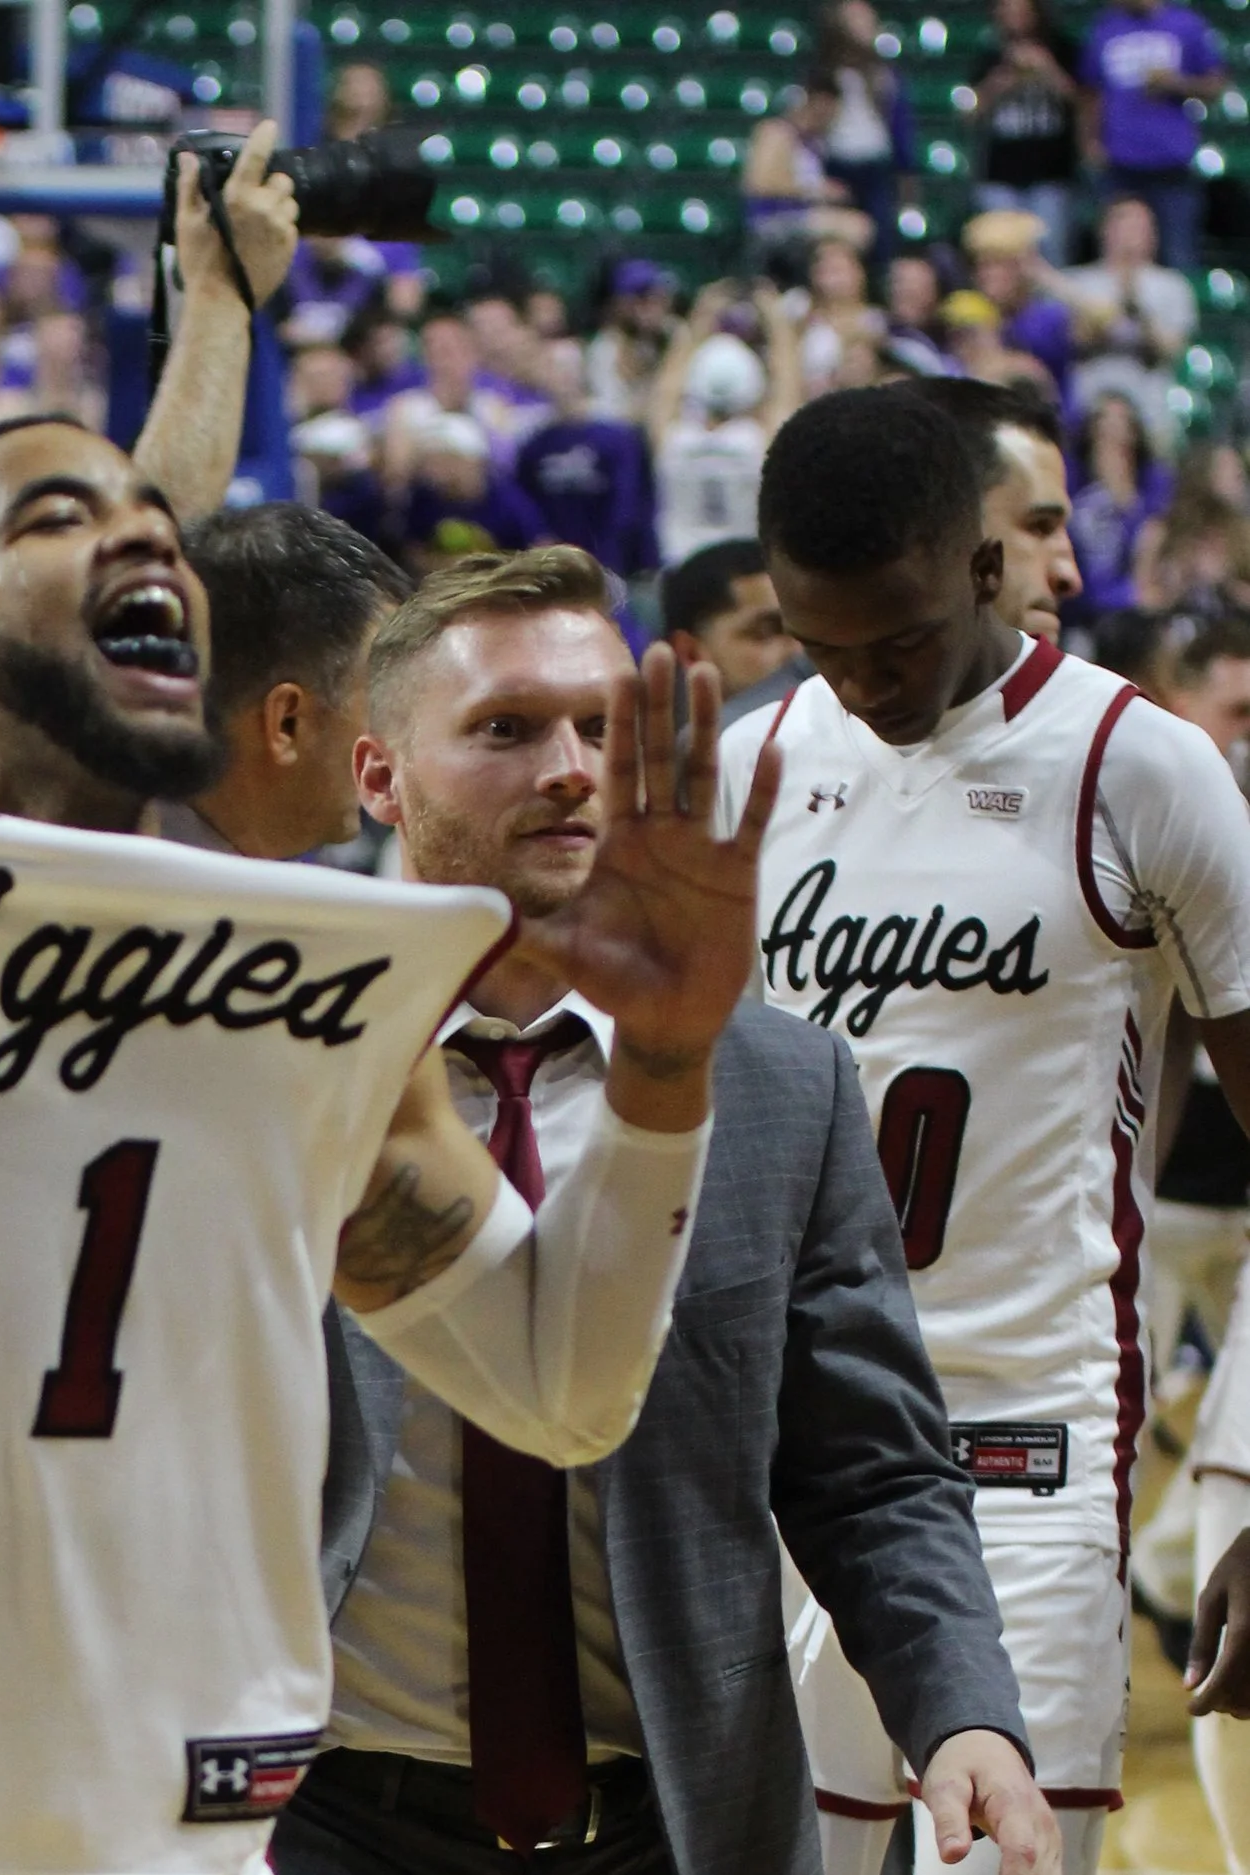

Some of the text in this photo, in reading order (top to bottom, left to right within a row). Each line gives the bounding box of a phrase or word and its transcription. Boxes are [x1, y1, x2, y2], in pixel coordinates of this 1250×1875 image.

[966, 789, 1023, 813] WAC
[761, 858, 1049, 1038] Aggies
[31, 1138, 160, 1439] 1
